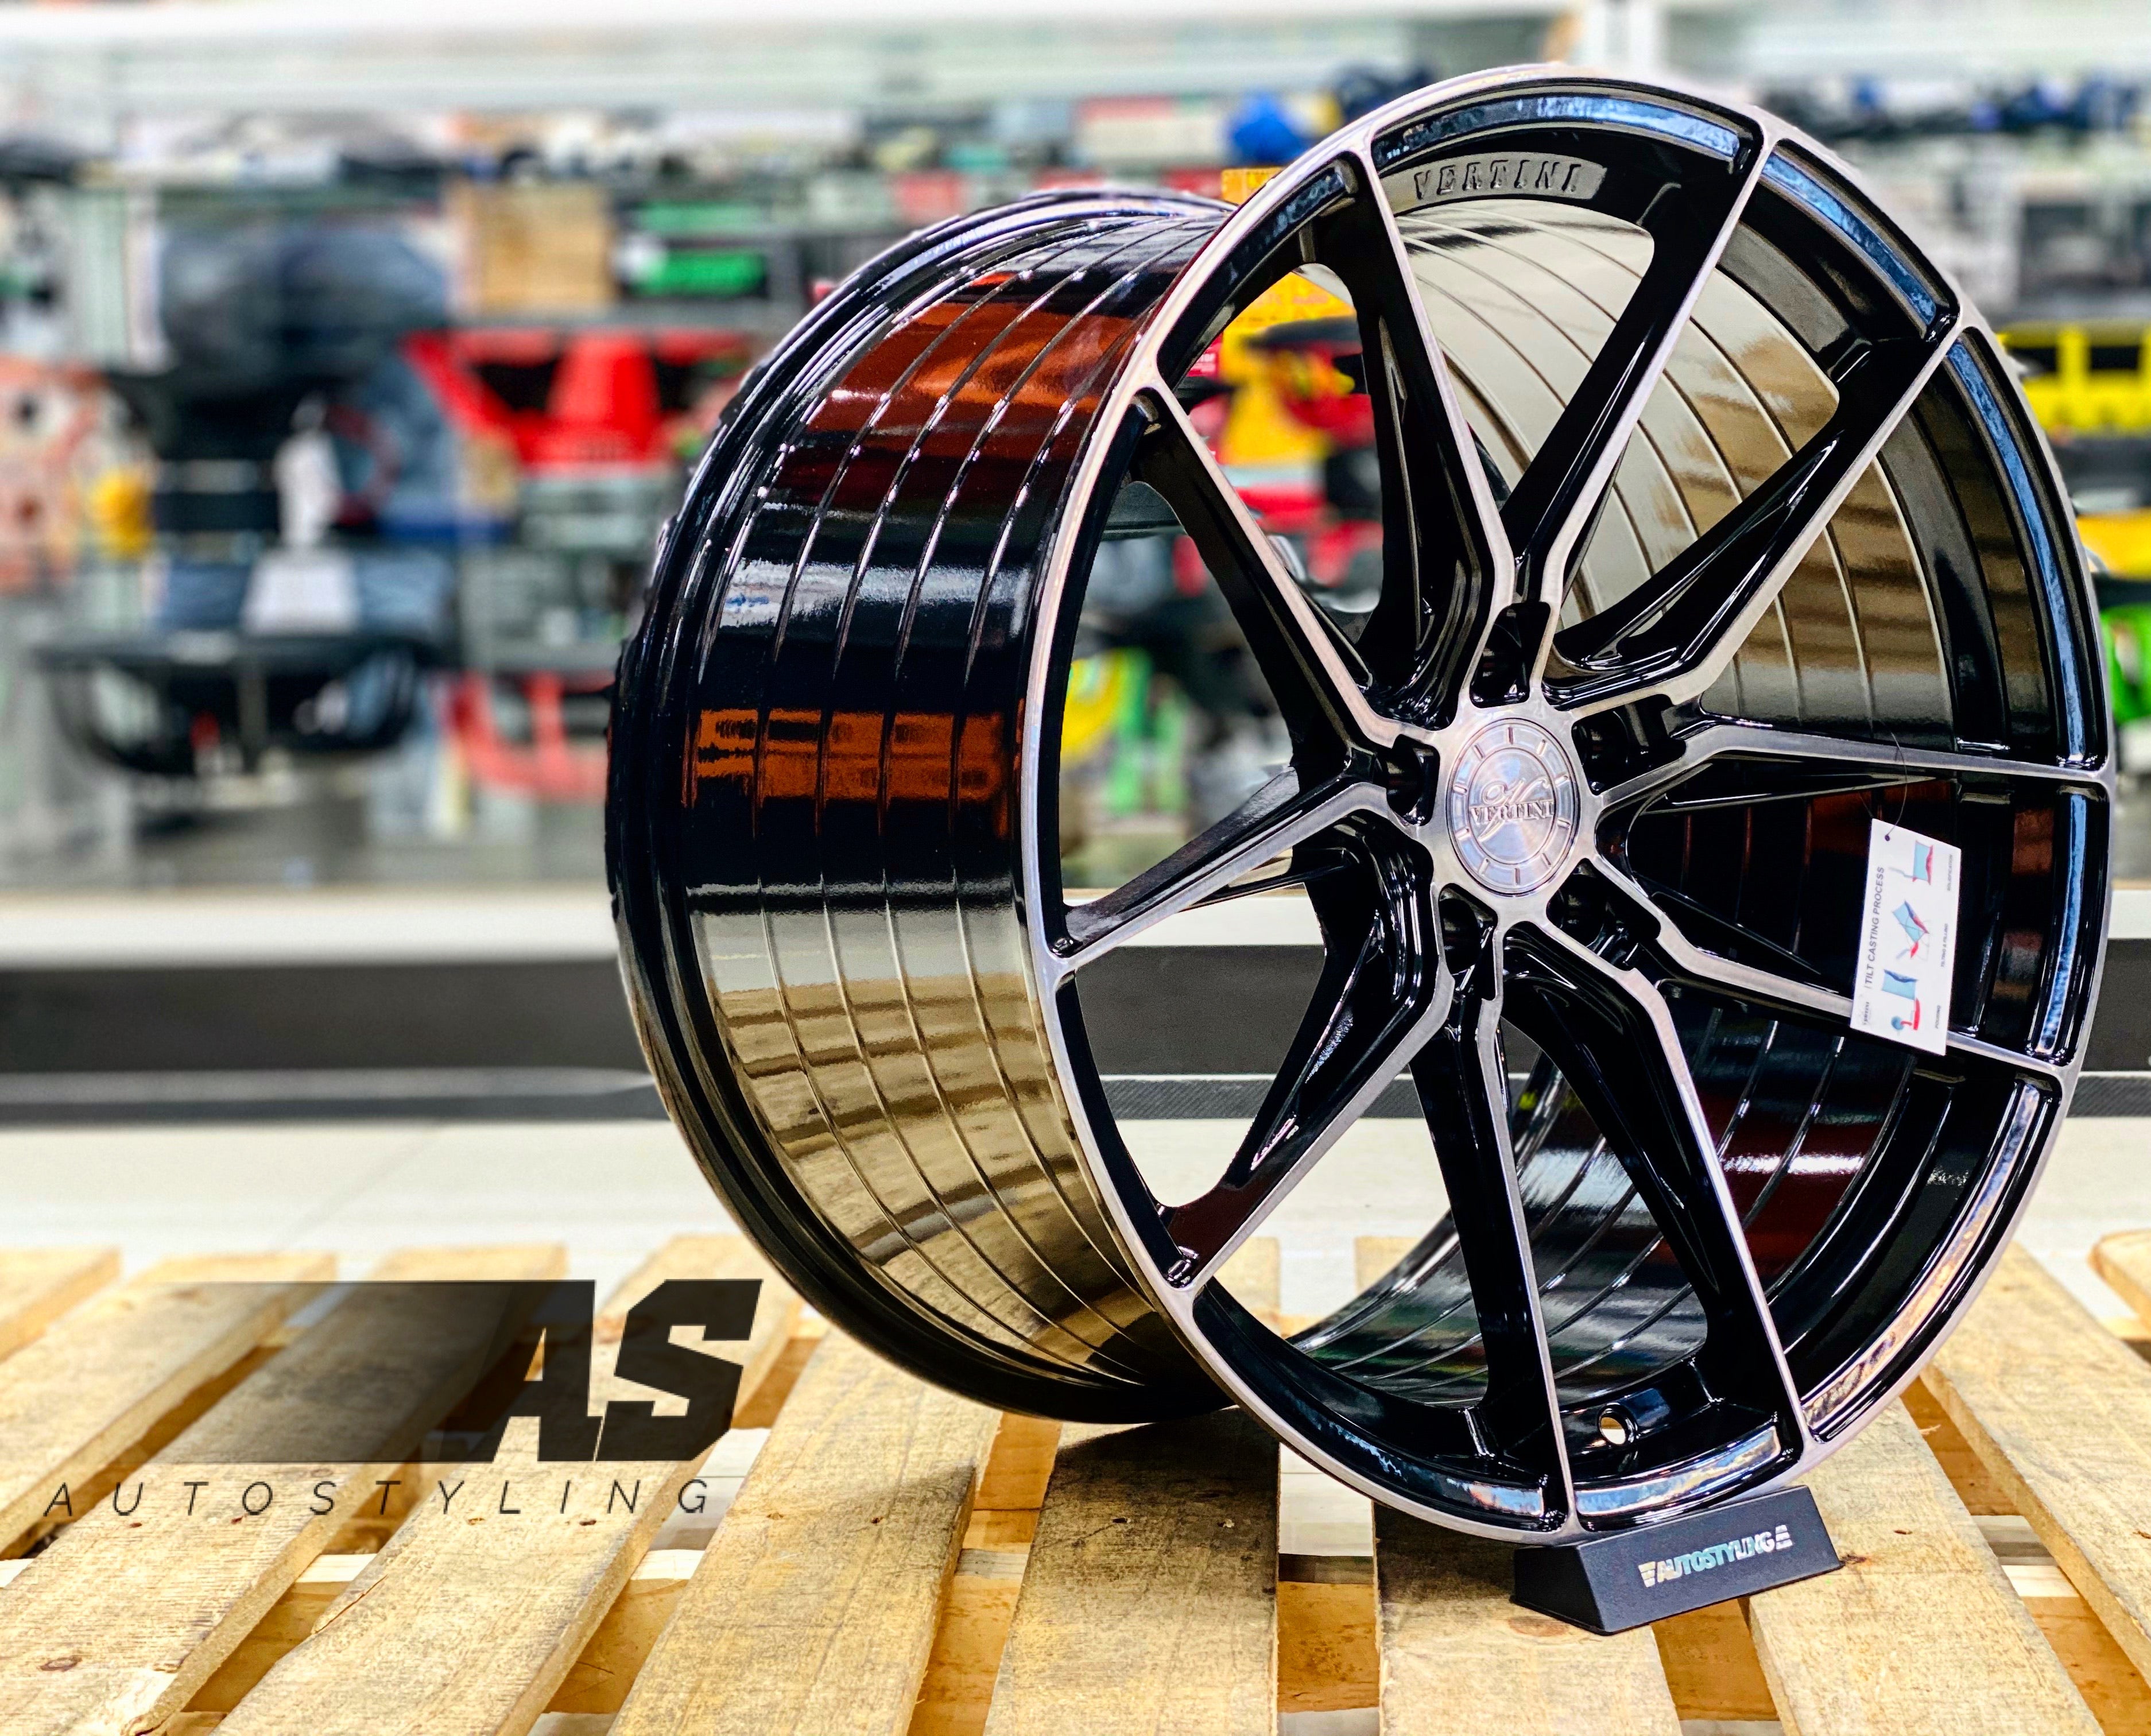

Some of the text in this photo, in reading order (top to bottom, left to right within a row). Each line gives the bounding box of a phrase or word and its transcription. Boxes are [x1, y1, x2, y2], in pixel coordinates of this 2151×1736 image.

[1414, 160, 1582, 199] VERTINI
[1470, 801, 1553, 825] VERTINI
[1865, 866, 1885, 985] TILT CASTING PROCESS
[1656, 1530, 1776, 1583] AUTOSTYLING
